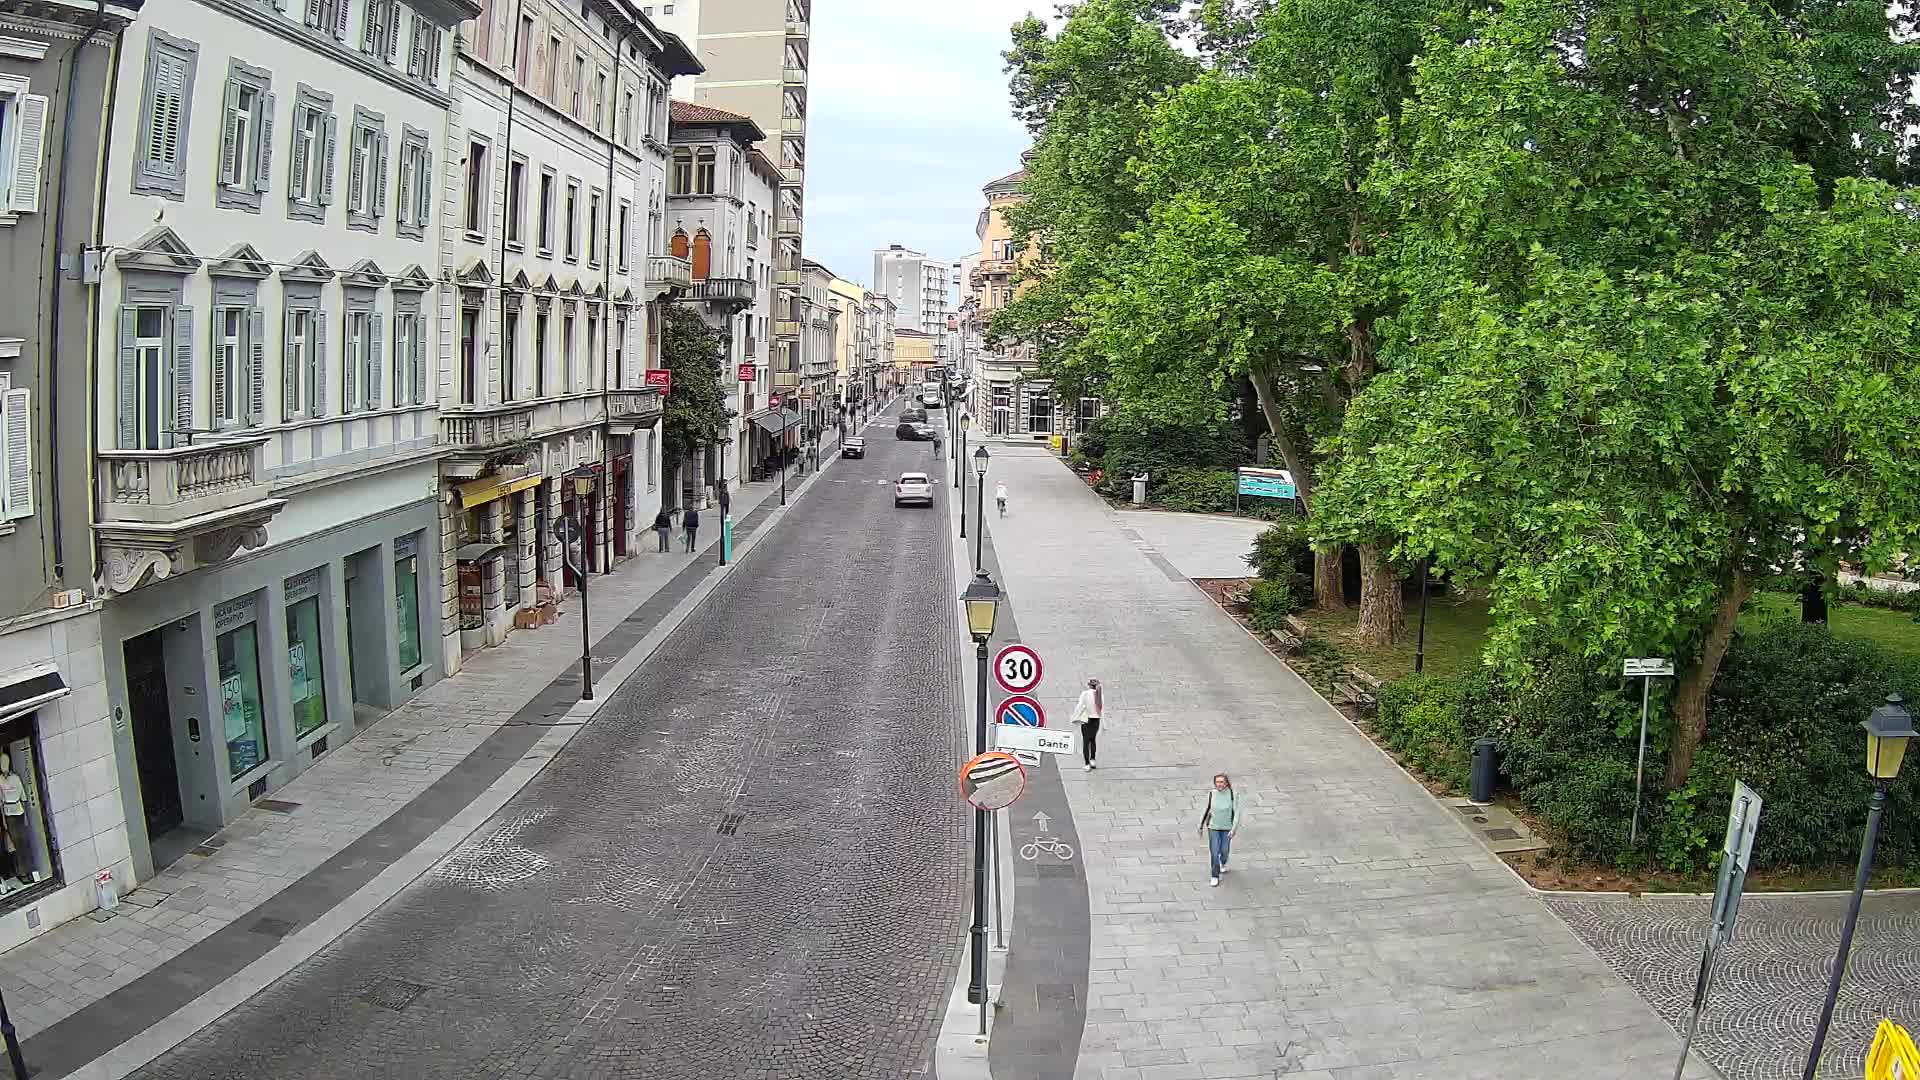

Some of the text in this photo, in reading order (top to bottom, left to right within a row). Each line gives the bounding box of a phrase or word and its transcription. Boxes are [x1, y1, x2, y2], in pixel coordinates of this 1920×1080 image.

[1005, 658, 1032, 680] 30
[222, 678, 240, 700] 130
[1038, 738, 1069, 749] Dante
